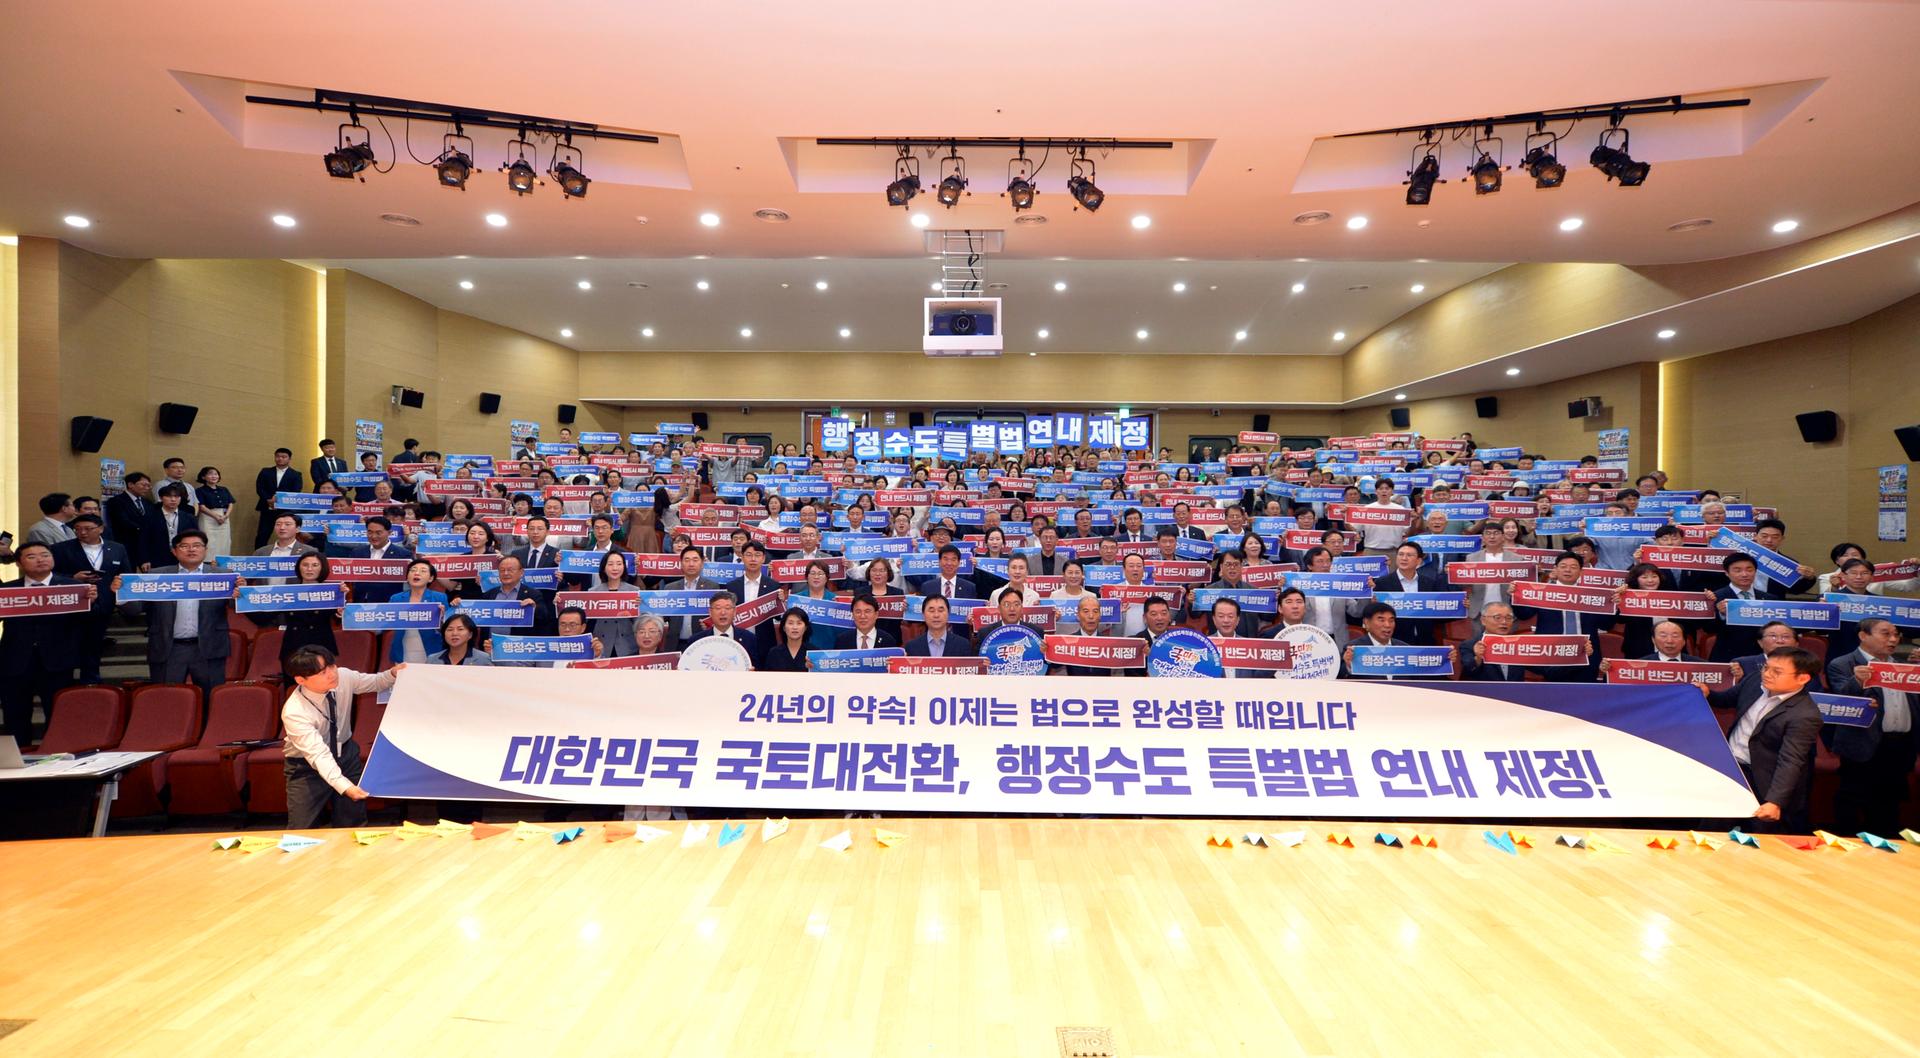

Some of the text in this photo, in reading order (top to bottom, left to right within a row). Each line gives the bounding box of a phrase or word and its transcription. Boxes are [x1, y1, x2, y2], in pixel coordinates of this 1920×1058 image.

[1028, 417, 1081, 444] 연내
[1088, 419, 1147, 447] 제정
[1367, 512, 1387, 520] 반드시
[851, 544, 907, 554] 행정수도 특별법!
[1649, 552, 1702, 563] 연내 반드시
[227, 562, 266, 570] 행정수도
[332, 566, 403, 575] 연내 반드시 제정!
[447, 561, 492, 571] 반드시 제정!
[778, 567, 793, 575] 연내
[1164, 567, 1205, 576] 반드시 제정!
[1090, 572, 1120, 580] 행정수도
[1457, 568, 1528, 578] 연내 반드시 제정!
[131, 581, 229, 593] 행정수도 특별법!
[1292, 580, 1363, 591] 행정수도 특별법!
[47, 594, 78, 606] 제정!
[249, 590, 335, 604] 행정수도 특별법!
[1240, 595, 1269, 605] 특별법!
[1522, 589, 1605, 606] 연내 반드시 제정!
[649, 598, 685, 608] 행정수도
[1386, 600, 1458, 610] 행정수도 특별법!
[1625, 597, 1708, 611] 연내 반드시 제정!
[355, 611, 431, 621] 행정수도 특별법!
[494, 609, 524, 619] 특별법!
[1740, 606, 1830, 621] 행정수도 특별법!
[980, 615, 1048, 625] 연내 제정!
[502, 642, 584, 653] 행정수도 특별법!
[1054, 645, 1136, 659] 연내 반드시 제정!
[1492, 644, 1578, 657] 연내 반드시 제정!
[1225, 647, 1258, 659] 반드시
[1260, 649, 1285, 661] 제정!
[819, 658, 860, 668] 행정수도
[1361, 655, 1442, 667] 행정수도 특별법!
[1618, 669, 1722, 684] 연내 반드시 제정!
[1880, 671, 1905, 683] 연내
[739, 694, 1357, 730] 24년의 약속! 이제는 법으로 완성할 때입니다
[500, 735, 1612, 799] 대한민국 국토대전환, 행정수도 특별법 연내 제정!
